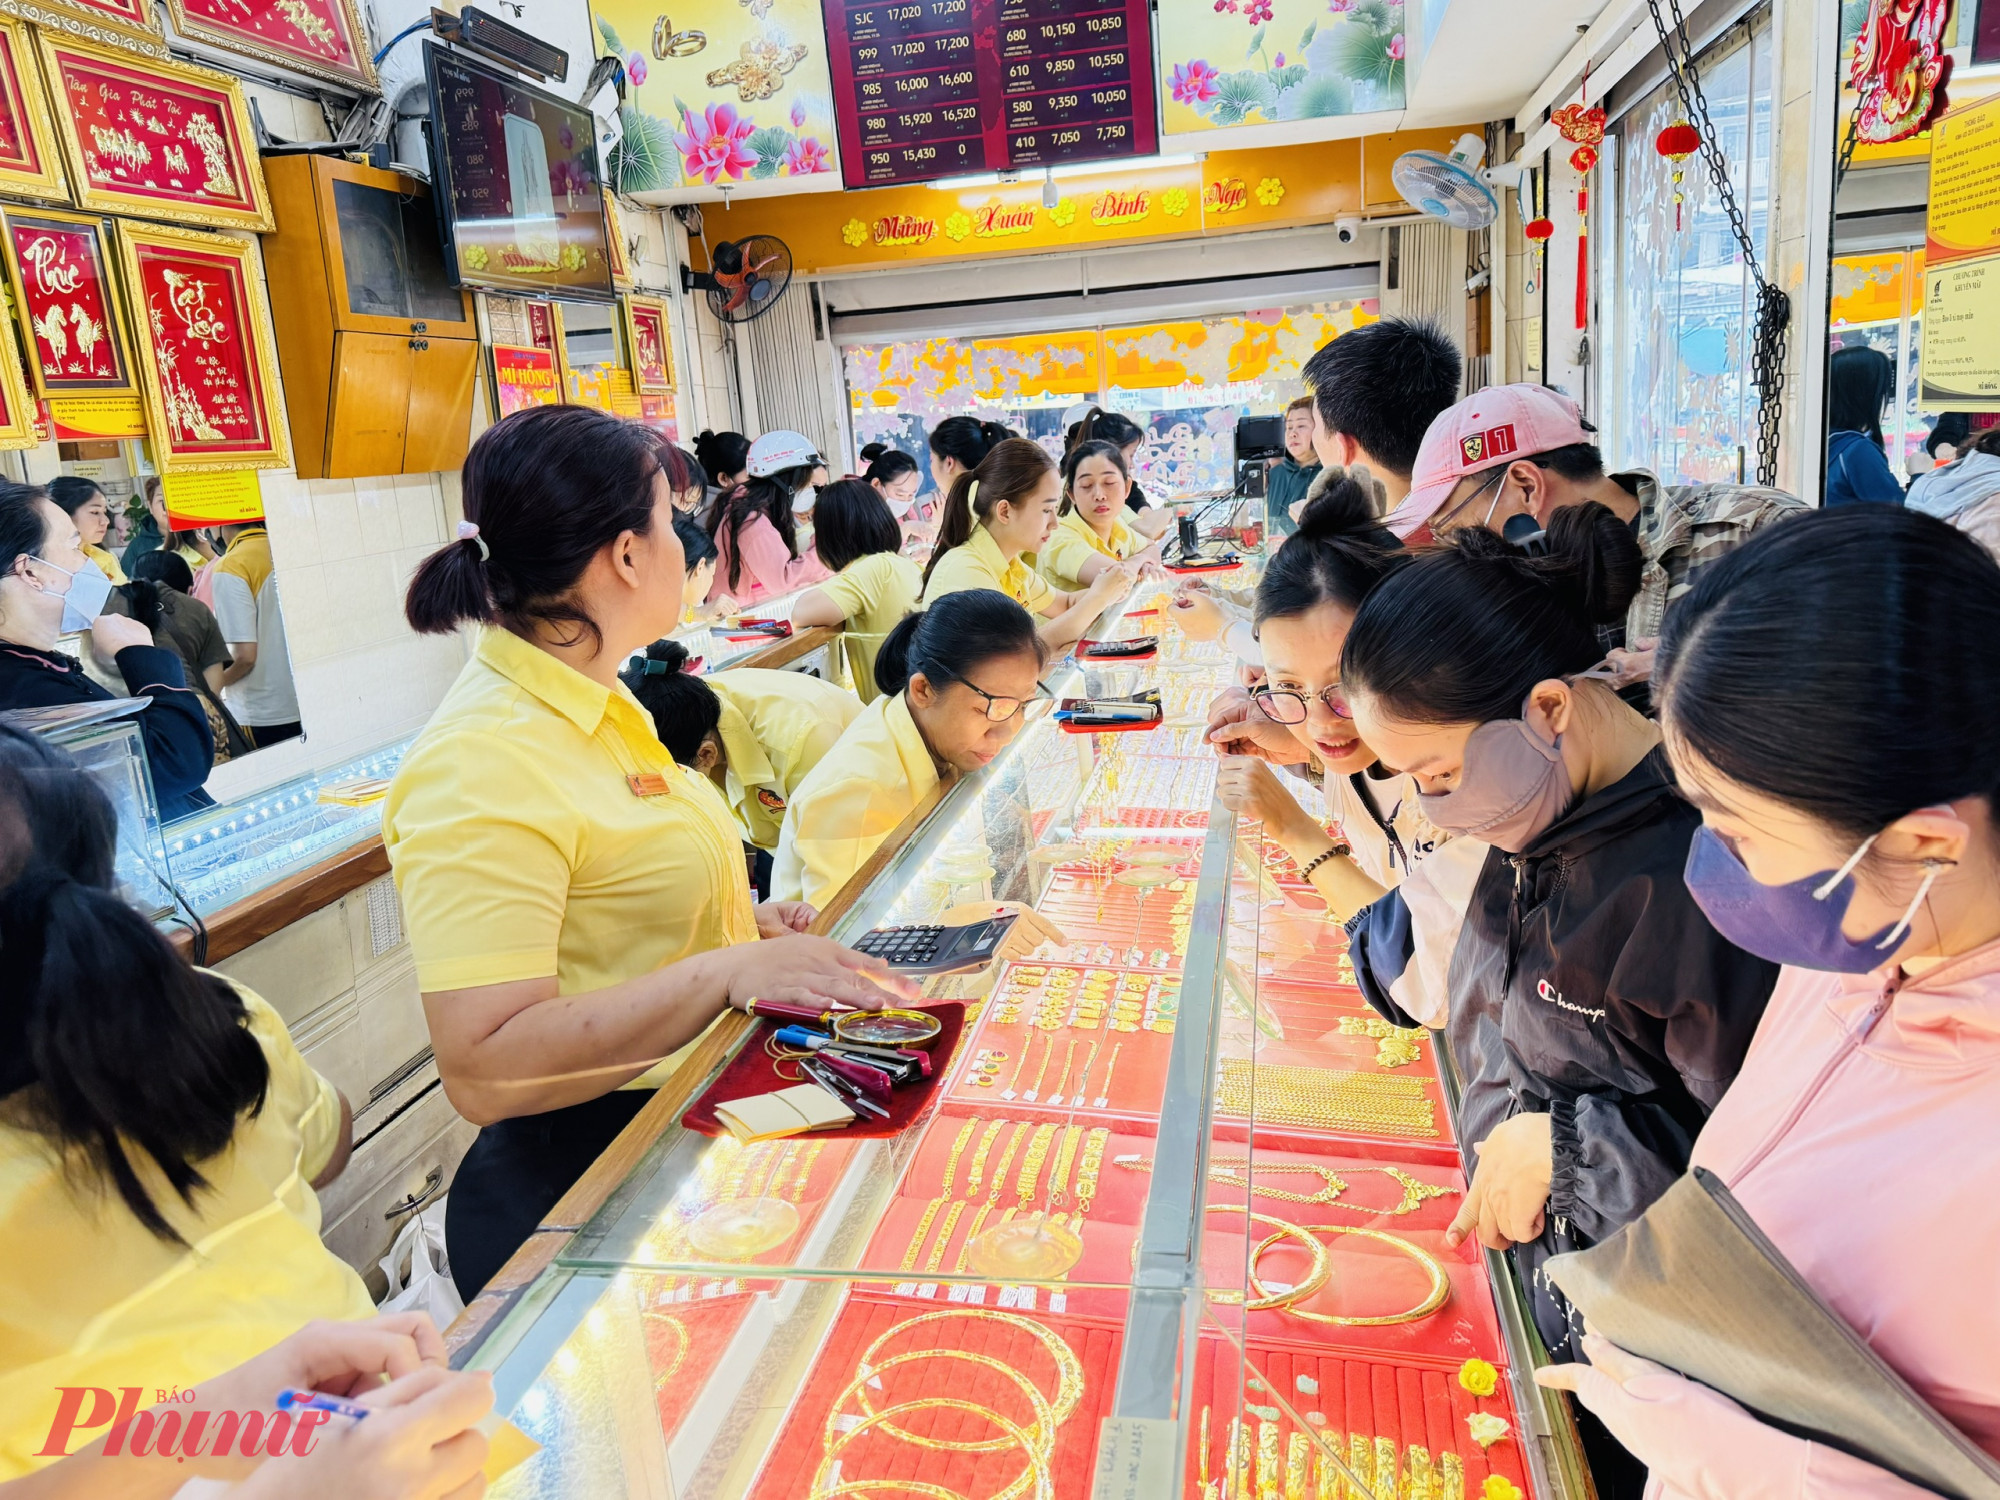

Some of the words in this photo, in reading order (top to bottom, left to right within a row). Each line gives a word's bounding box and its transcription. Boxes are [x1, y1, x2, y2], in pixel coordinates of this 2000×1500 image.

[854, 12, 874, 25] SJC
[887, 5, 922, 21] 17,020
[931, 0, 966, 15] 17,200
[1006, 29, 1027, 42] 680
[1040, 22, 1076, 38] 10,150
[1086, 16, 1122, 32] 10,850
[858, 47, 878, 60] 999
[890, 41, 925, 57] 17,020
[935, 36, 970, 51] 17,200
[1009, 64, 1030, 77] 610
[1045, 59, 1075, 74] 9,850
[1089, 53, 1125, 69] 10,550
[862, 82, 882, 95] 985
[894, 77, 929, 92] 16,000
[938, 71, 973, 86] 16,600
[99, 82, 120, 103] Gia
[130, 90, 157, 109] Phát
[163, 99, 182, 115] Tài
[1012, 100, 1033, 113] 580
[1049, 95, 1078, 110] 9,350
[1091, 89, 1127, 105] 10,050
[866, 117, 886, 130] 980
[899, 112, 933, 127] 15,920
[942, 107, 976, 122] 16,520
[1015, 136, 1036, 149] 410
[1051, 131, 1081, 146] 7,050
[1096, 125, 1126, 140] 7,750
[870, 152, 890, 165] 950
[902, 147, 936, 162] 15,430
[958, 144, 966, 155] 0
[874, 215, 934, 245] Mừng
[975, 204, 1034, 233] Xuân
[1091, 190, 1149, 219] Bính
[1204, 178, 1245, 214] Ngọ
[519, 361, 551, 386] HỒNG
[1494, 427, 1508, 453] 1
